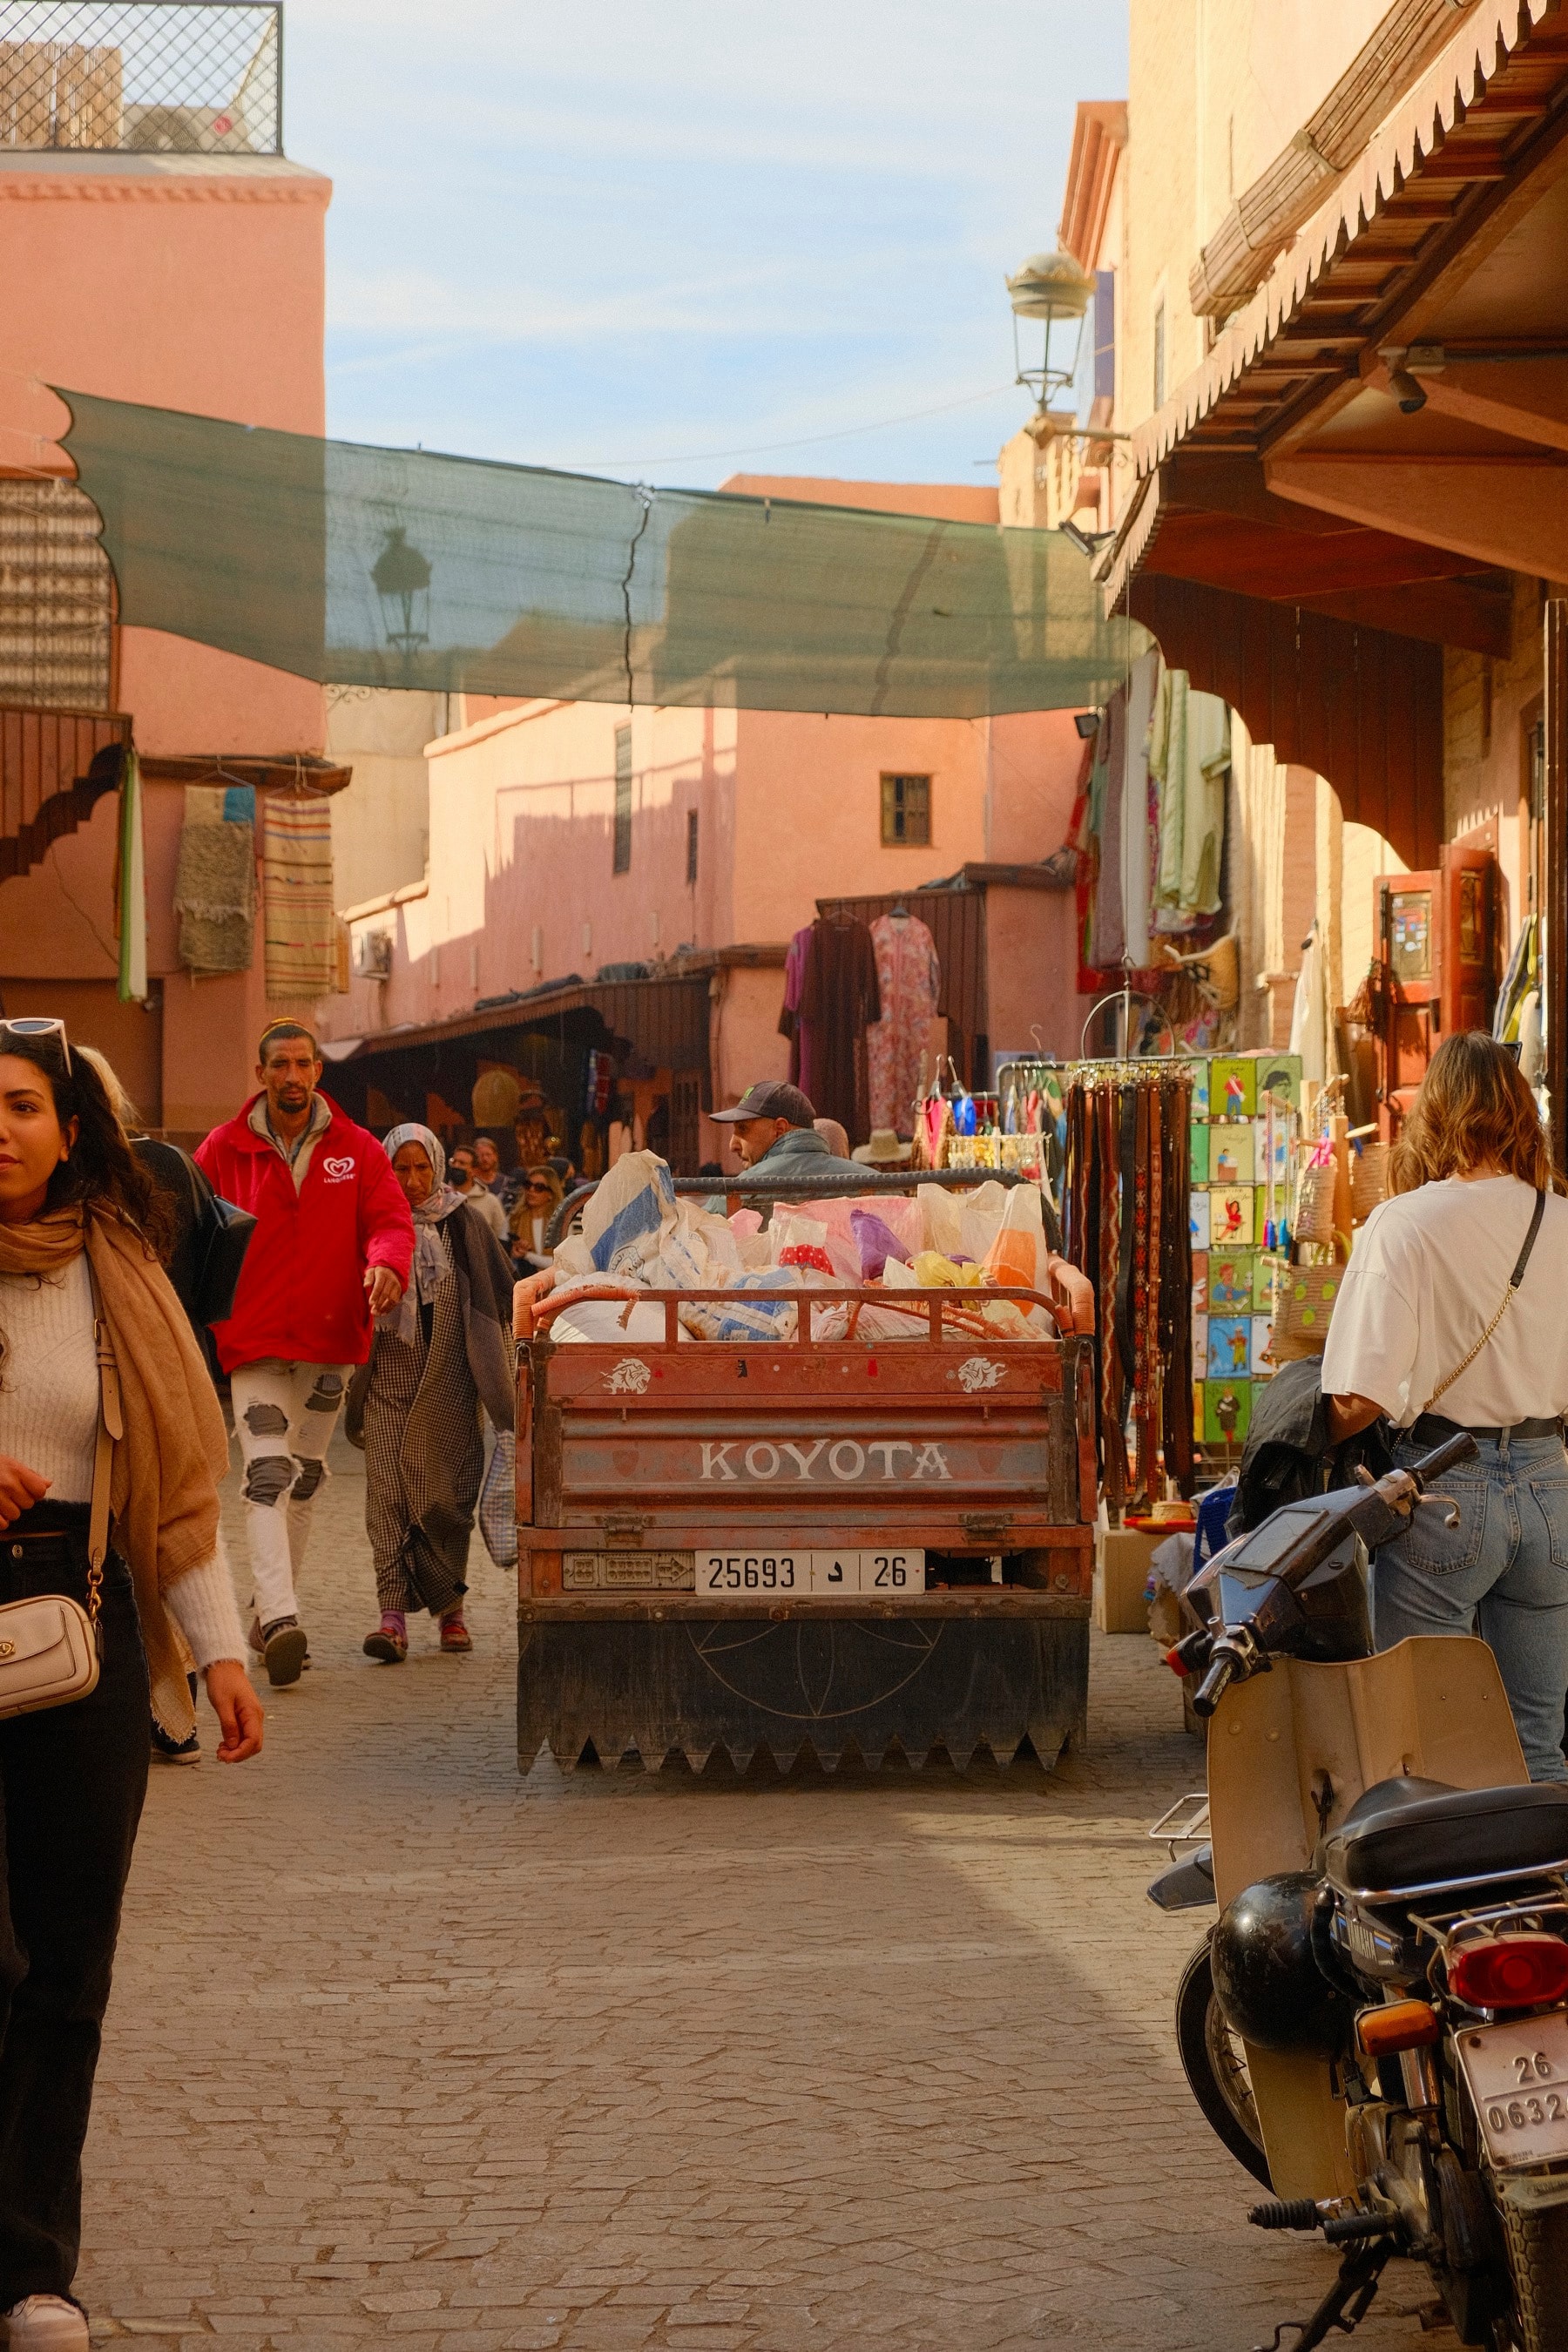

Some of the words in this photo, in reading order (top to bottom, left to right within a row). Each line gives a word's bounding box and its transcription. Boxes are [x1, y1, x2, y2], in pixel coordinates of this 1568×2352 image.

[699, 1438, 954, 1481] KOYOTA
[708, 1558, 795, 1589] 25693
[828, 1561, 844, 1583] د
[874, 1557, 907, 1587] 26
[1512, 2051, 1553, 2085] 26
[1486, 2092, 1568, 2135] 0632
